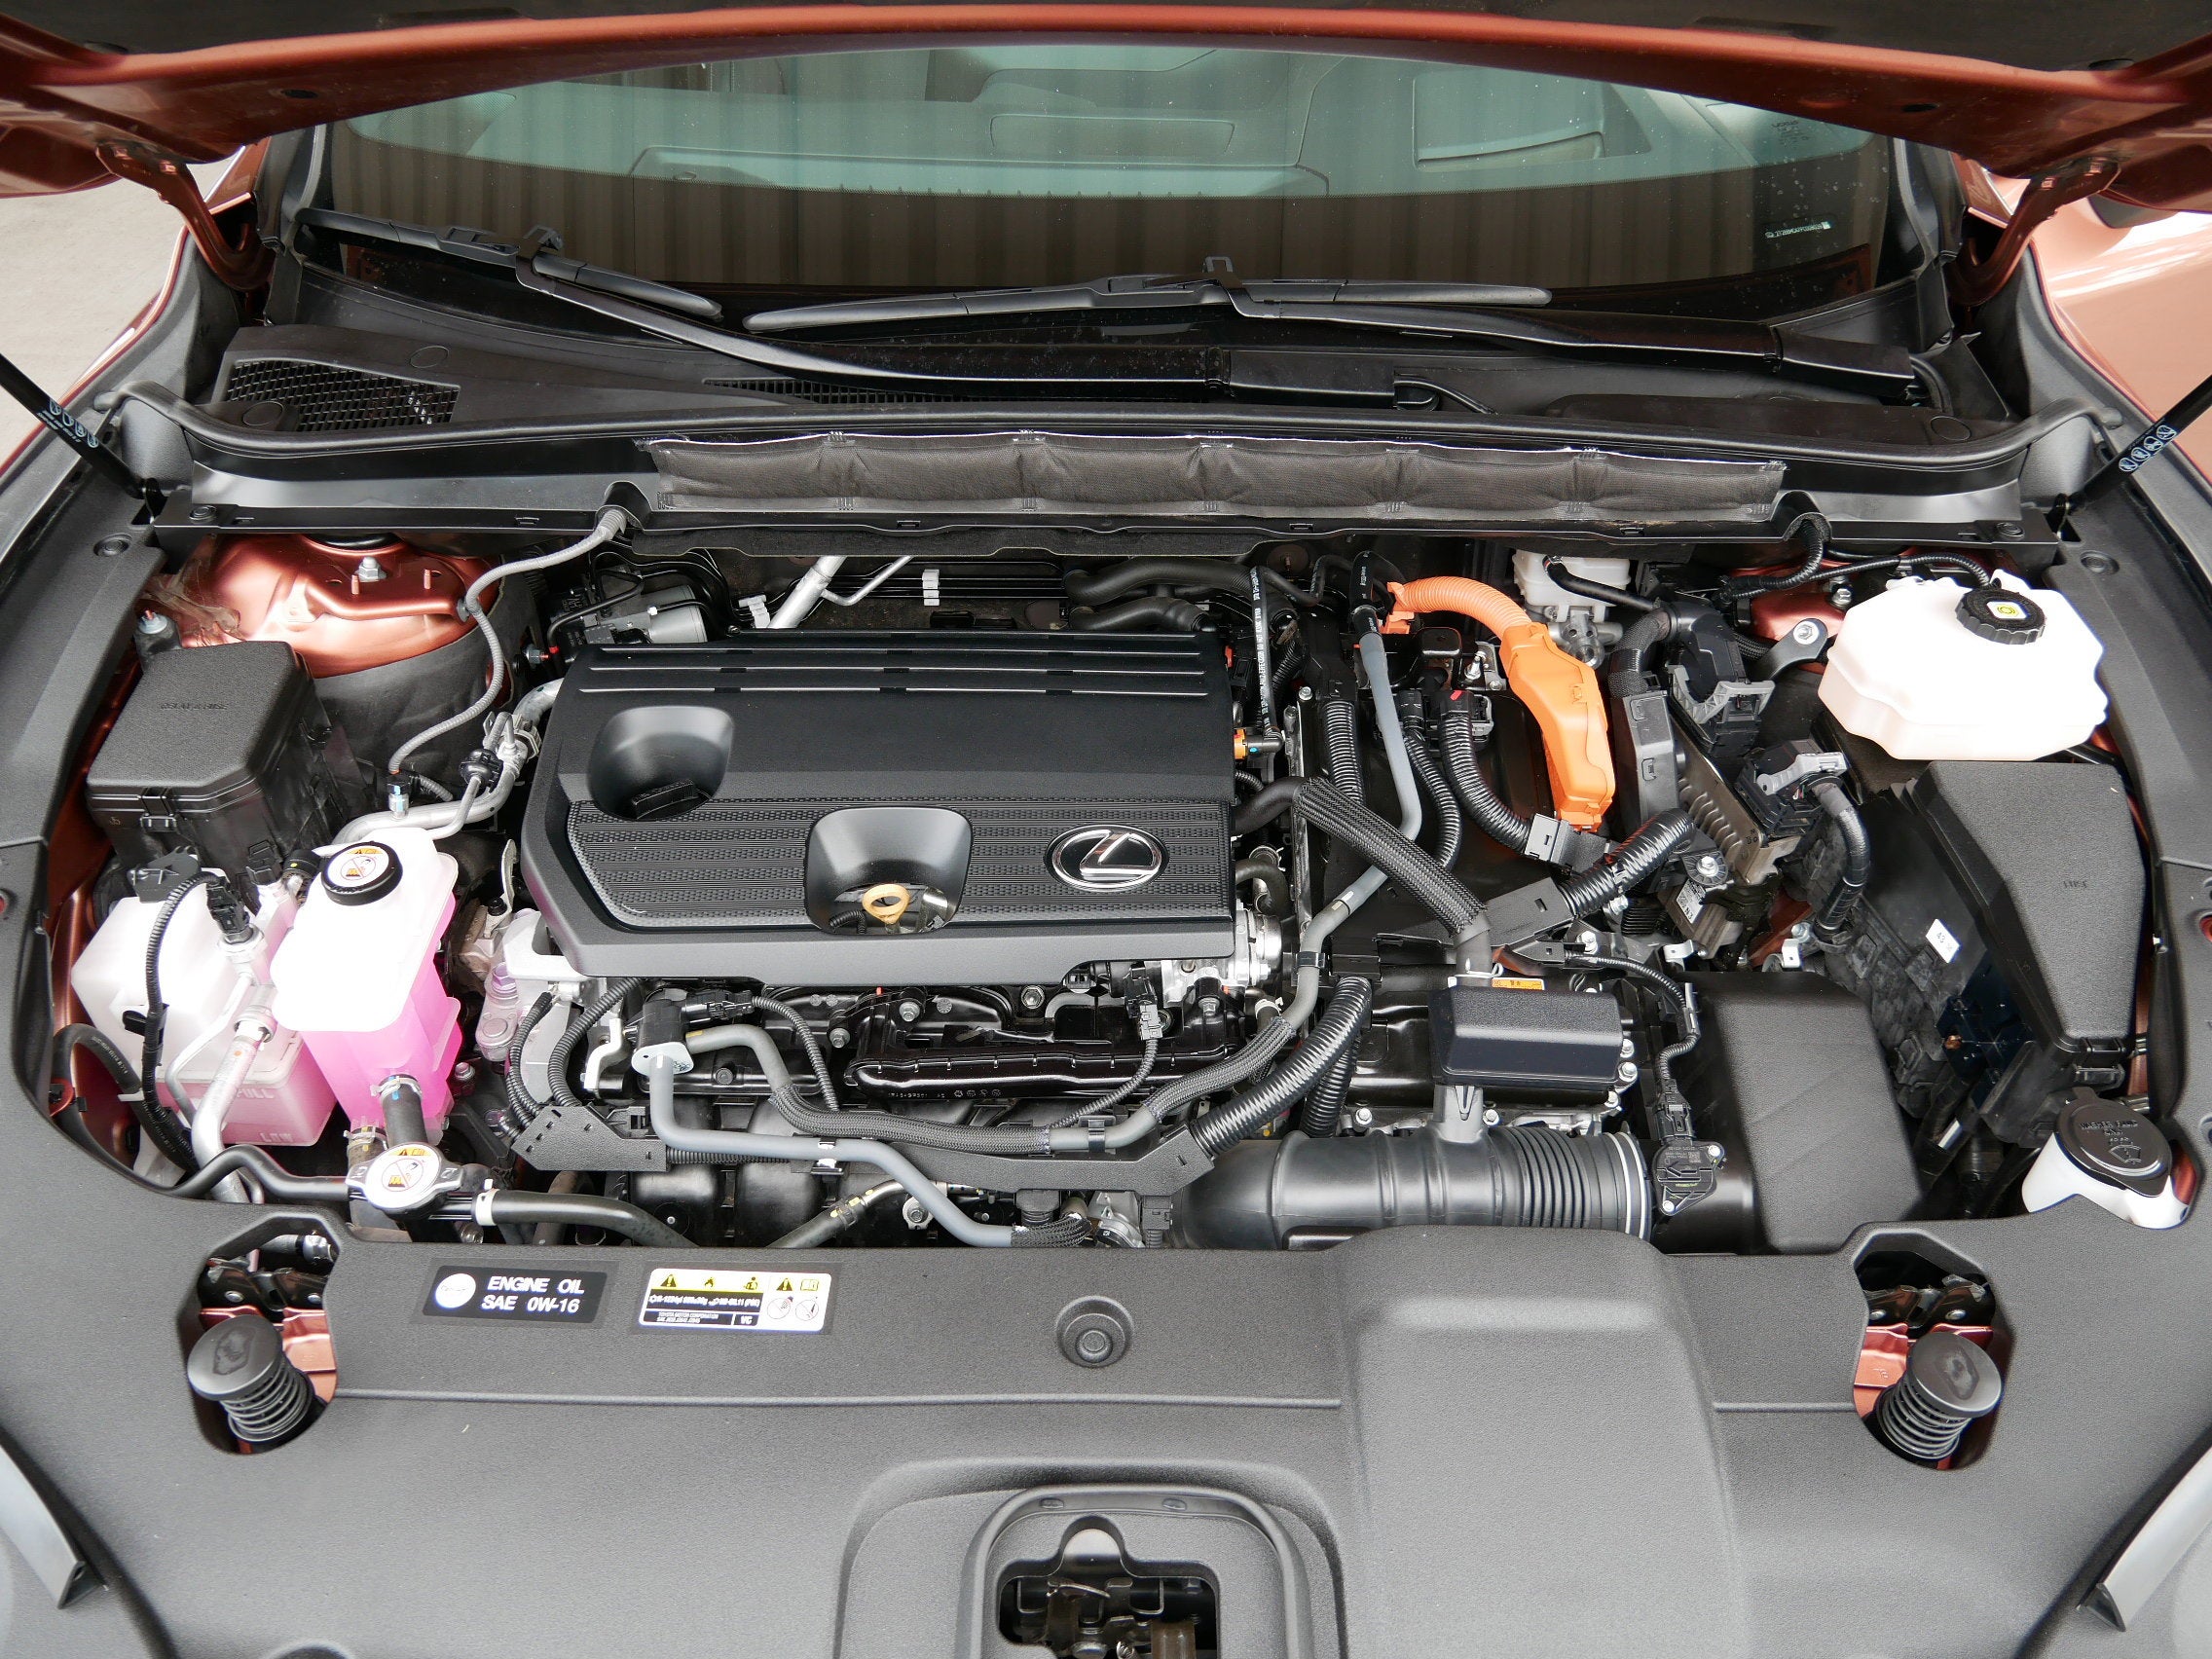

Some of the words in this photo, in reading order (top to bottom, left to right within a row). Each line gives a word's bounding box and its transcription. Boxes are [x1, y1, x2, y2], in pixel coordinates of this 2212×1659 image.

[487, 1275, 551, 1293] ENGINE
[557, 1278, 585, 1295] OIL
[481, 1294, 519, 1310] SAE
[527, 1296, 581, 1313] 0W-16
